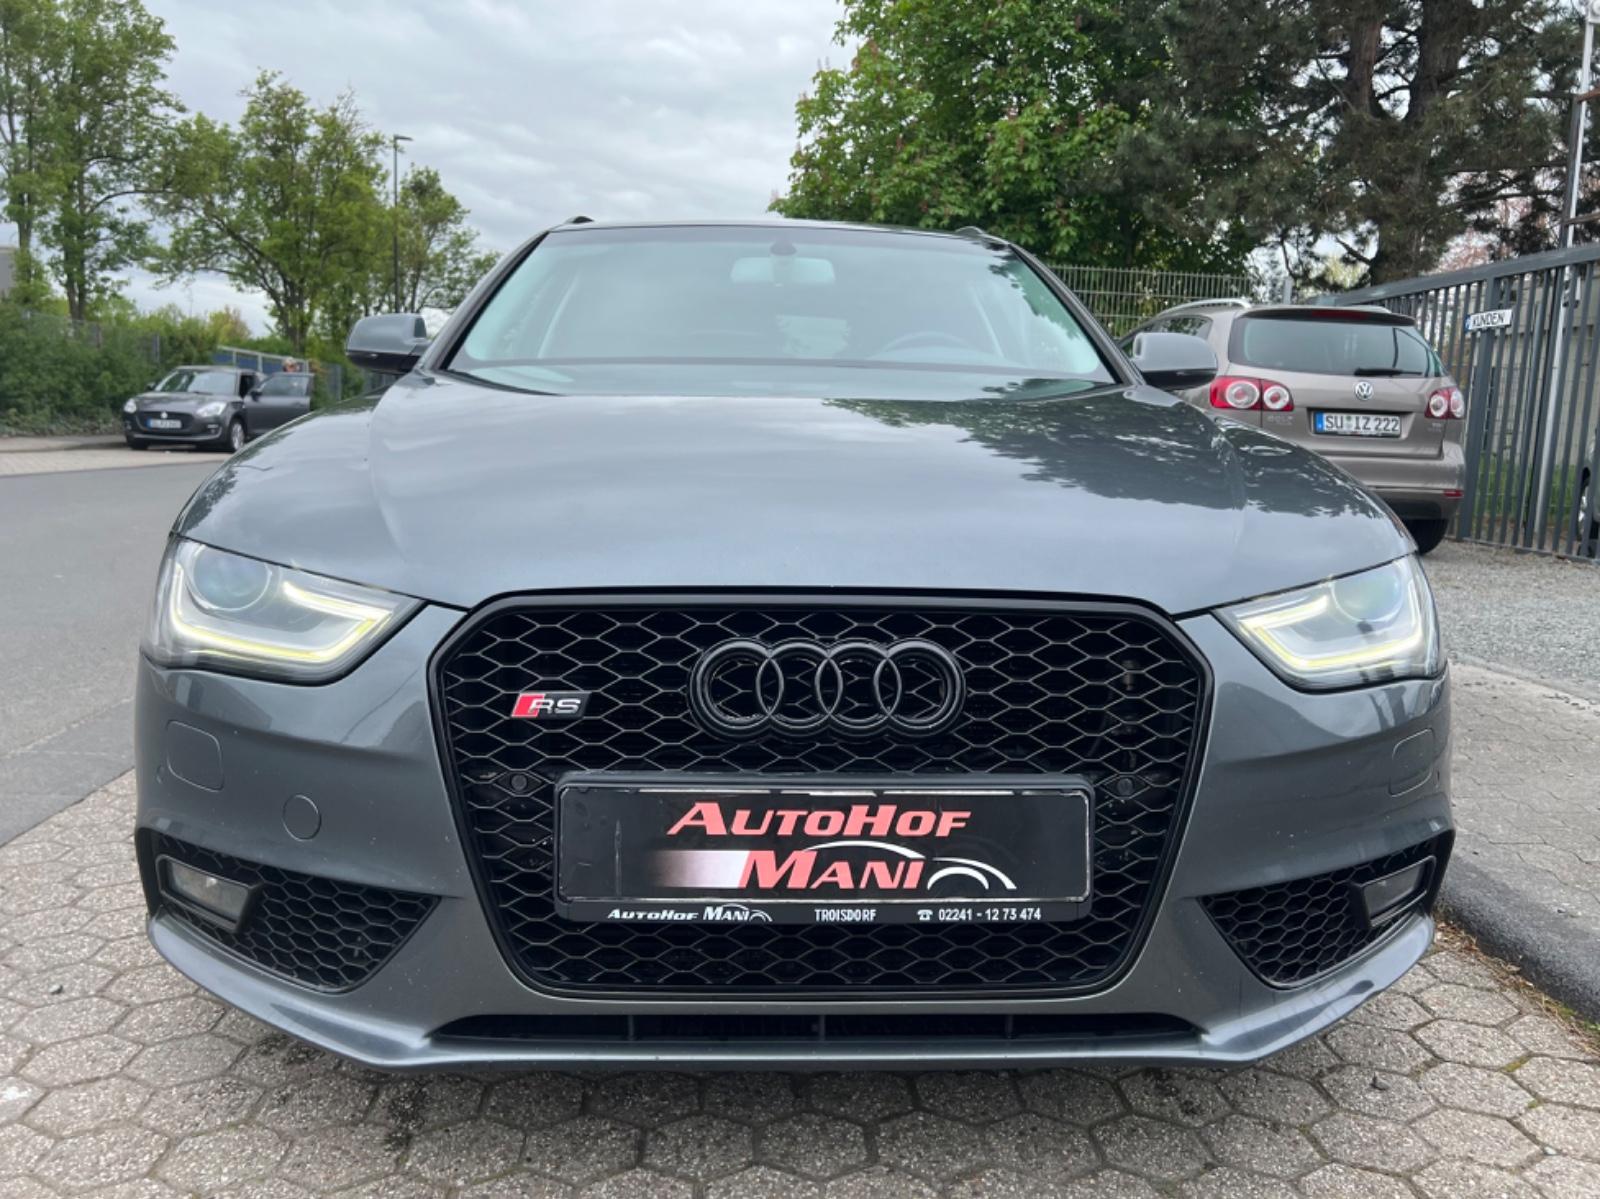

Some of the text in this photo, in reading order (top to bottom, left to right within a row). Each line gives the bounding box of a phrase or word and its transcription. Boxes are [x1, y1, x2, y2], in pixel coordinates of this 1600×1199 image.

[1471, 312, 1505, 327] KUNDEN
[1326, 415, 1399, 432] SU IZ 222
[528, 698, 581, 714] RS
[814, 908, 877, 922] TROISDORF
[938, 908, 973, 921] 02241
[985, 908, 1000, 921] 12
[1002, 907, 1018, 921] 73
[1019, 907, 1042, 921] 474
